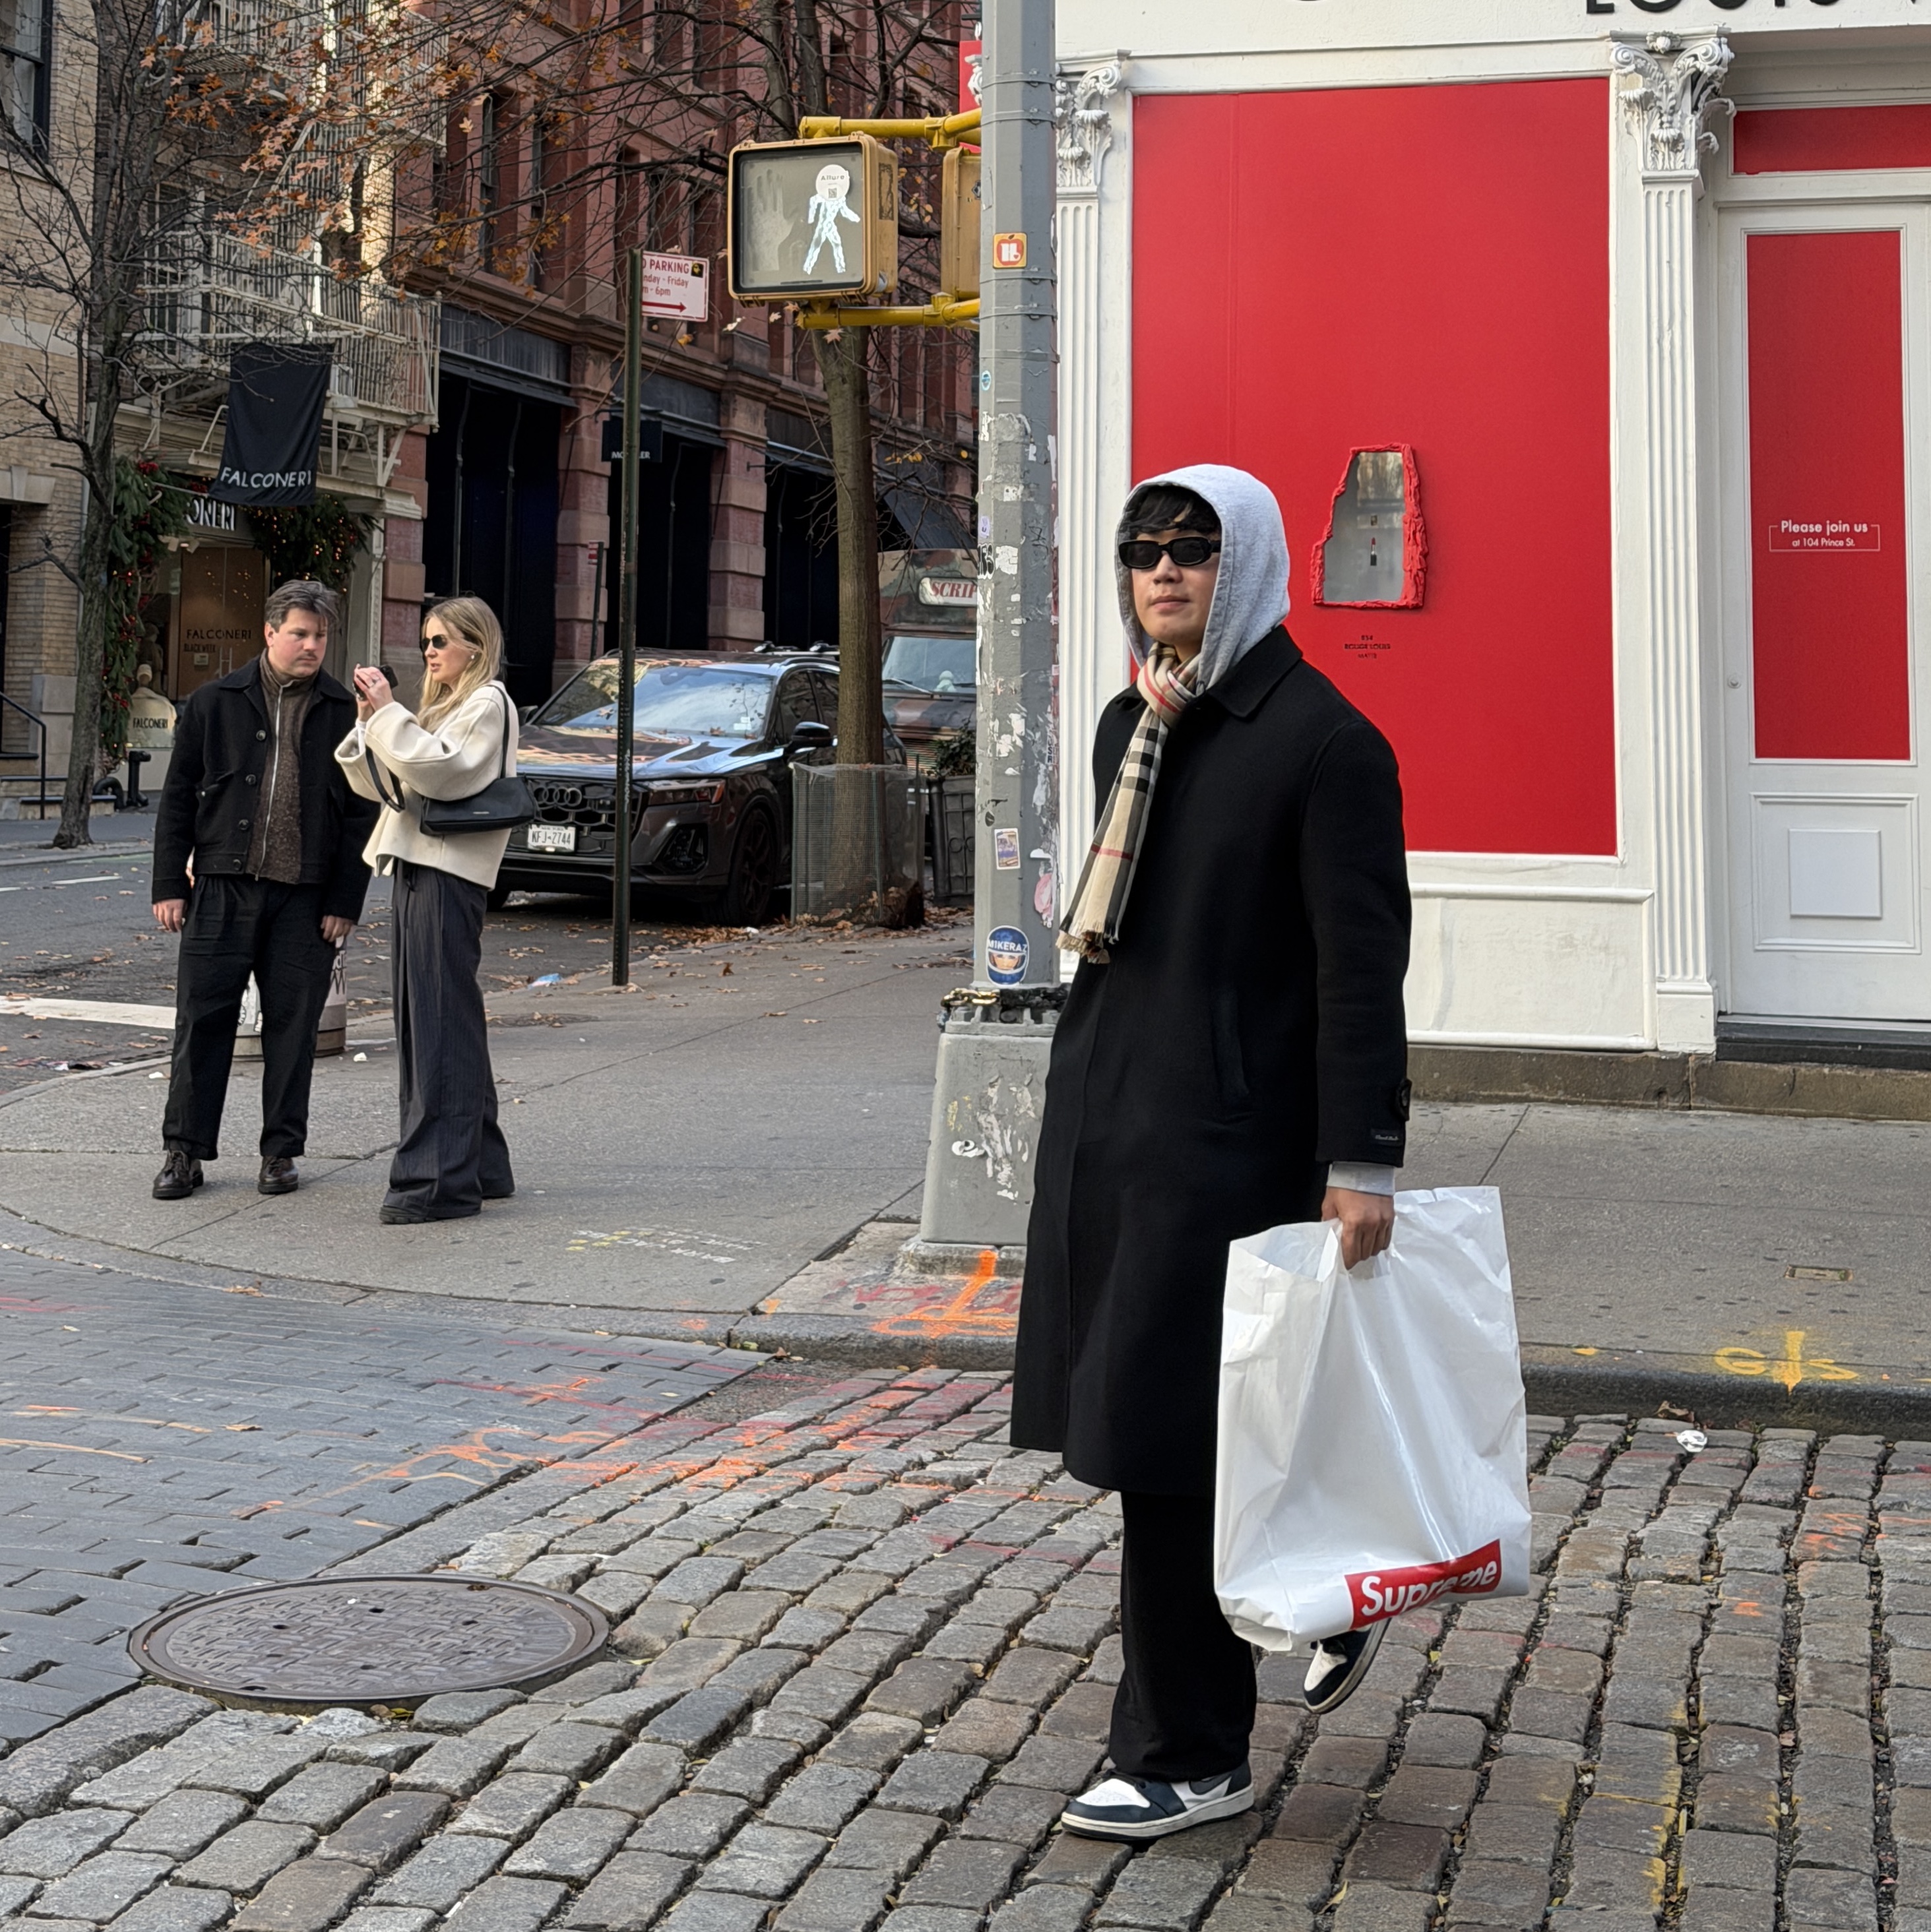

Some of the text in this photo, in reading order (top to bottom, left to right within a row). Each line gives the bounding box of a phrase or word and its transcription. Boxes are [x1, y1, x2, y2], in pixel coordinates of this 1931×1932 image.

[650, 259, 689, 274] PARKING
[643, 274, 661, 285] nday
[668, 276, 689, 288] Friday
[655, 286, 671, 296] 6pm
[220, 466, 311, 488] FALCONERI
[185, 497, 236, 531] ONERI
[1781, 519, 1868, 536] Please join us
[1792, 538, 1800, 547] at
[1803, 538, 1819, 547] 104
[1821, 537, 1844, 547] Prince
[931, 581, 976, 598] SCRIP
[186, 629, 251, 639] FALCONERI
[133, 716, 169, 729] FALCONERI
[1362, 1561, 1497, 1616] Supreme
